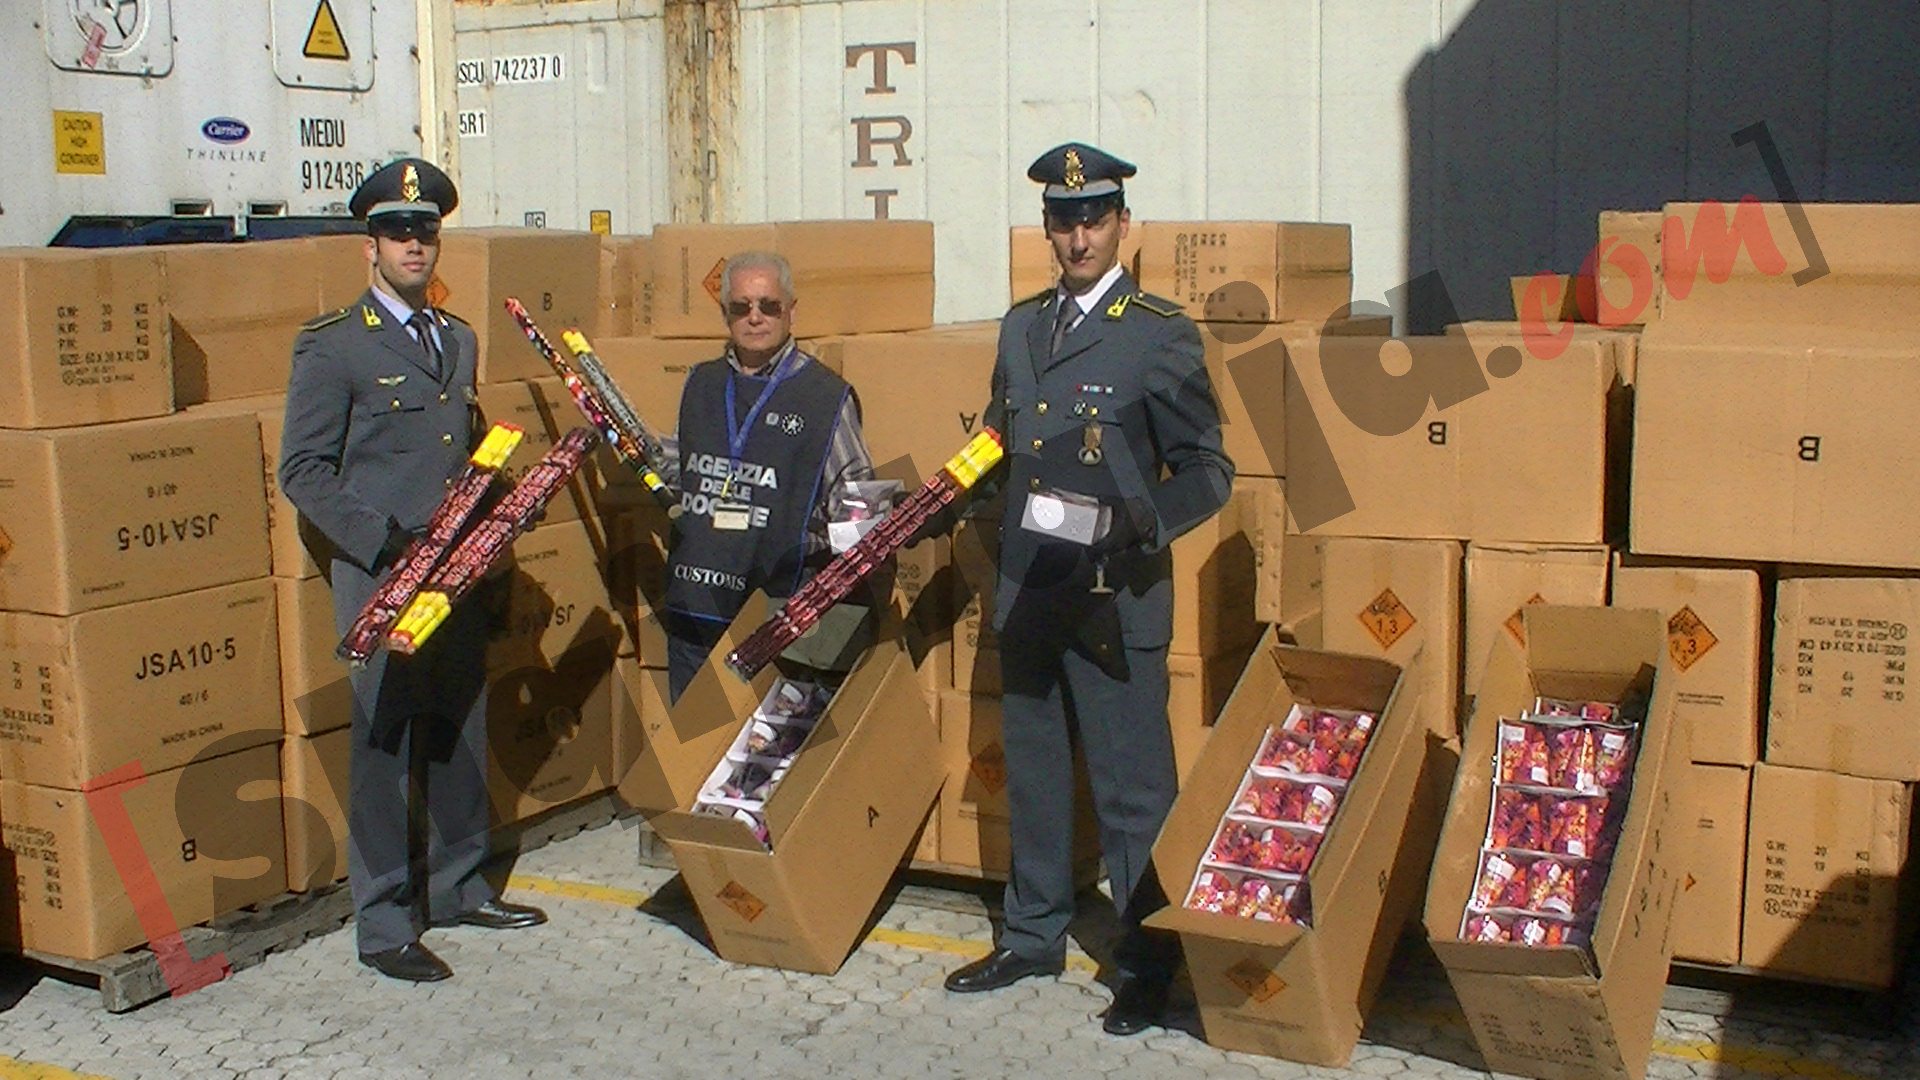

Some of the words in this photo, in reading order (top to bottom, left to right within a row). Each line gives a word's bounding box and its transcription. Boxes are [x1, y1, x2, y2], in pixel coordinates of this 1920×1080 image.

[458, 62, 484, 84] SCU
[493, 57, 546, 81] 742237
[208, 121, 245, 137] Carrier
[301, 119, 345, 147] MEDU
[187, 148, 267, 163] THINLINE
[303, 160, 364, 189] 912436
[959, 412, 977, 434] A
[1428, 421, 1447, 446] B
[1798, 436, 1821, 462] B
[681, 491, 770, 528] DOE
[674, 563, 747, 591] CUSTOMS
[867, 805, 880, 829] A
[182, 837, 197, 862] B
